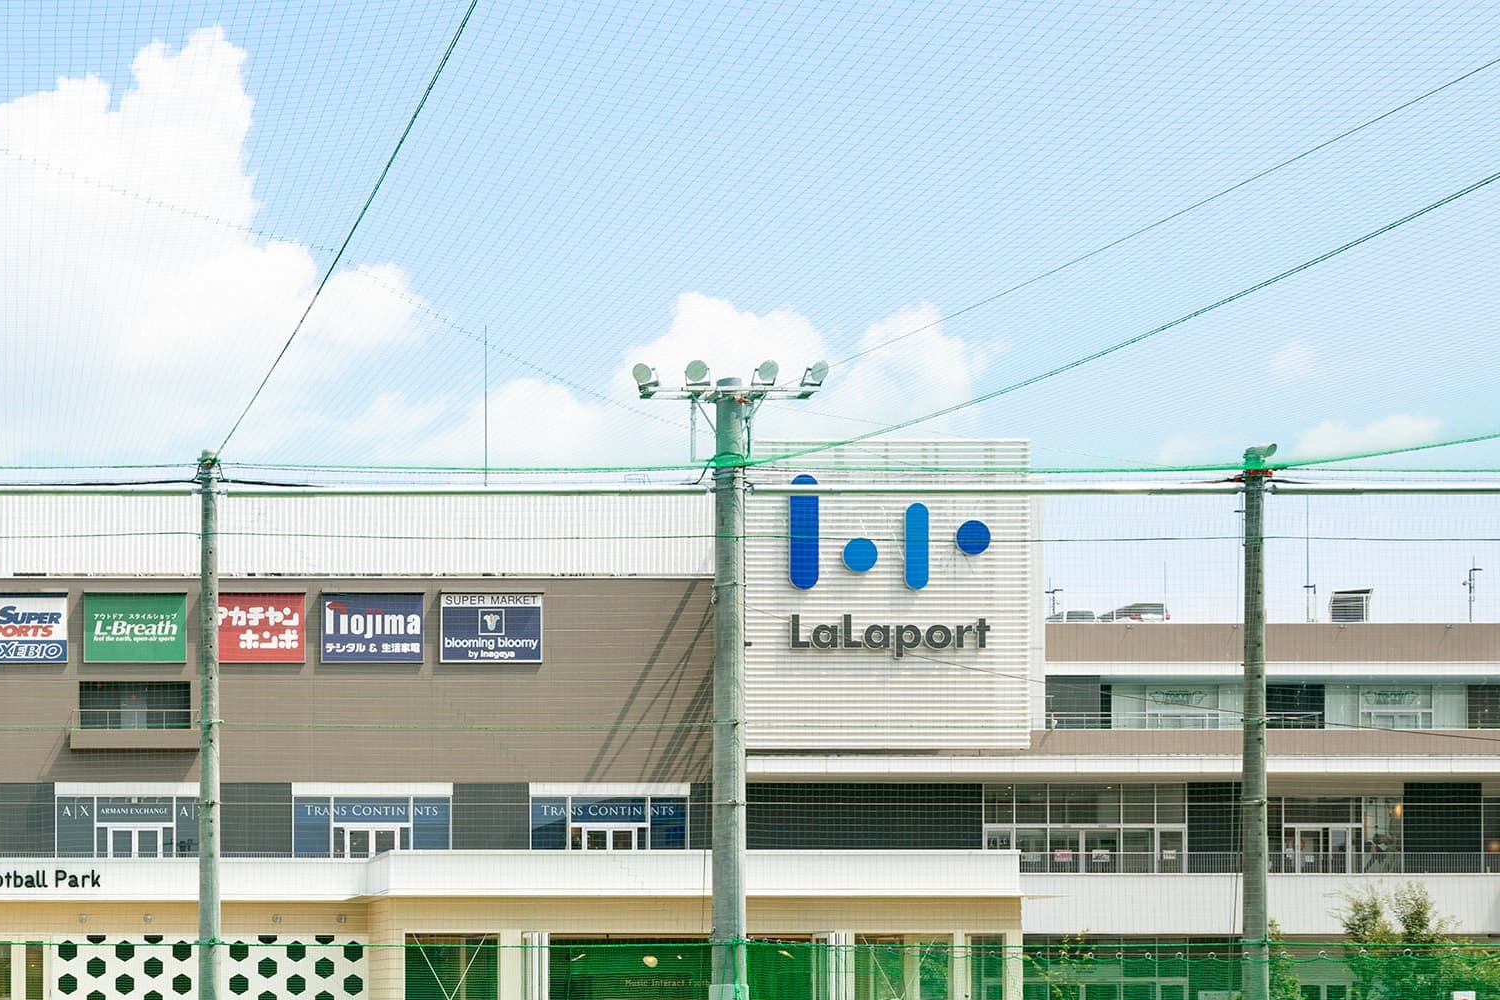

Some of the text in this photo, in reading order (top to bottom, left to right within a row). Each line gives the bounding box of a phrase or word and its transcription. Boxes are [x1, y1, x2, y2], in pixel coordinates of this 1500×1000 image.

[445, 595, 538, 605] SUPER MARKET
[94, 620, 178, 636] L-Breath
[788, 614, 991, 660] LaLaport
[369, 643, 377, 653] &
[444, 637, 538, 650] blooming bloomy
[468, 650, 478, 659] by
[352, 805, 438, 816] CONTINNTS
[588, 805, 675, 816] CONTINNTS
[55, 869, 100, 888] Park
